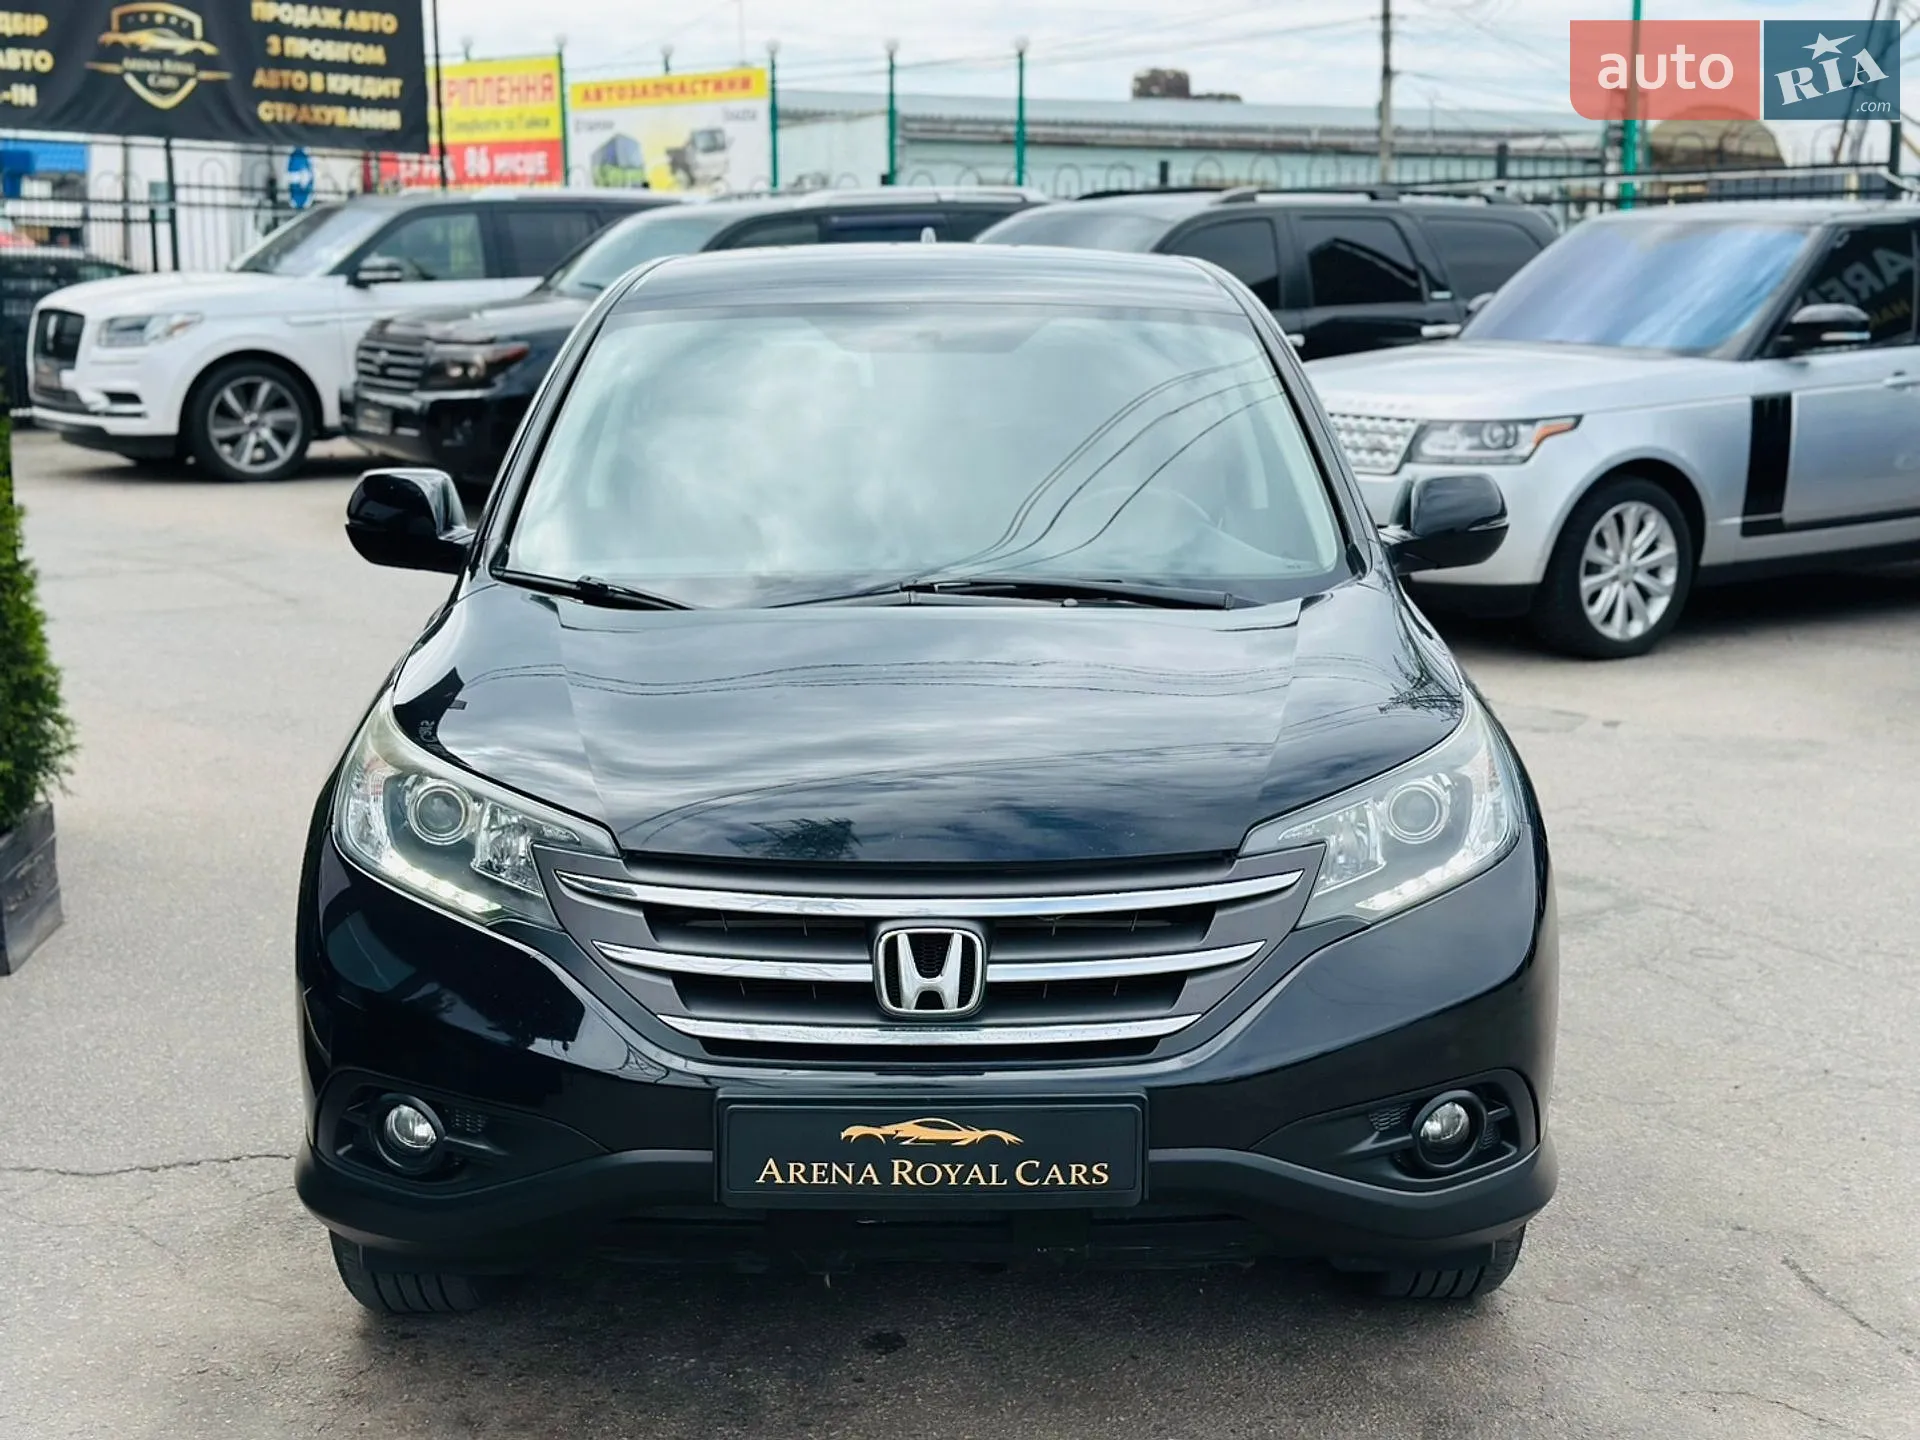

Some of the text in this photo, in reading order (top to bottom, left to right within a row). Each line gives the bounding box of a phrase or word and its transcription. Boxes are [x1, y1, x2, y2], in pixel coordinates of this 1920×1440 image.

[251, 0, 398, 34] ПРОДАЖ АВТО
[283, 36, 388, 65] ПРОБІГОМ
[252, 67, 404, 100] АВТО В КРЕДИТ
[755, 1157, 1109, 1187] ARENA ROYAL CARS
